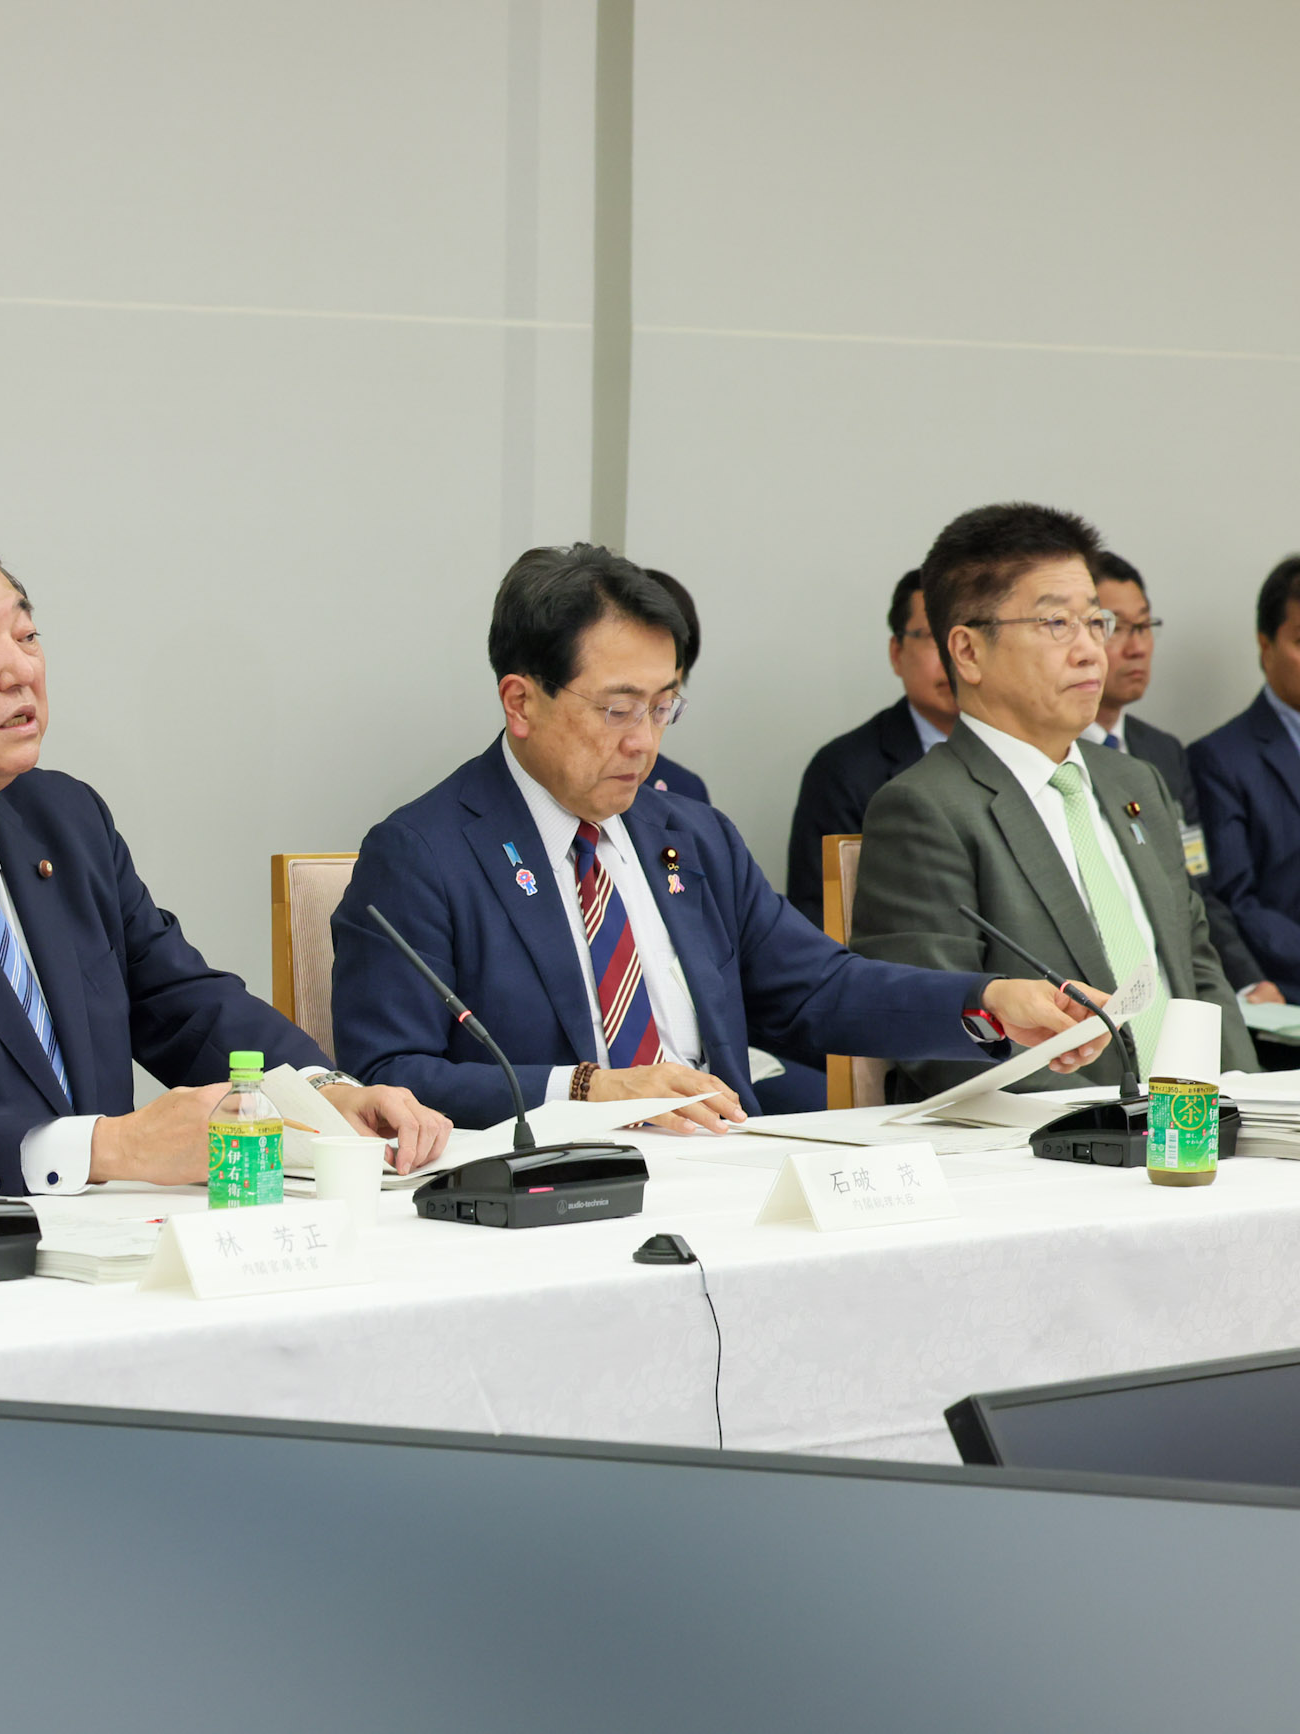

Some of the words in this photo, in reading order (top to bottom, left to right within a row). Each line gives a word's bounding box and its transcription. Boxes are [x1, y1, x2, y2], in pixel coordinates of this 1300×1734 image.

[1178, 1096, 1203, 1125] 茶
[1208, 1108, 1218, 1167] 伊右衛門
[829, 1167, 876, 1194] 石破
[897, 1162, 921, 1187] 茂
[568, 1199, 609, 1210] audio-technica
[215, 1231, 244, 1258] 林
[272, 1224, 328, 1253] 芳正
